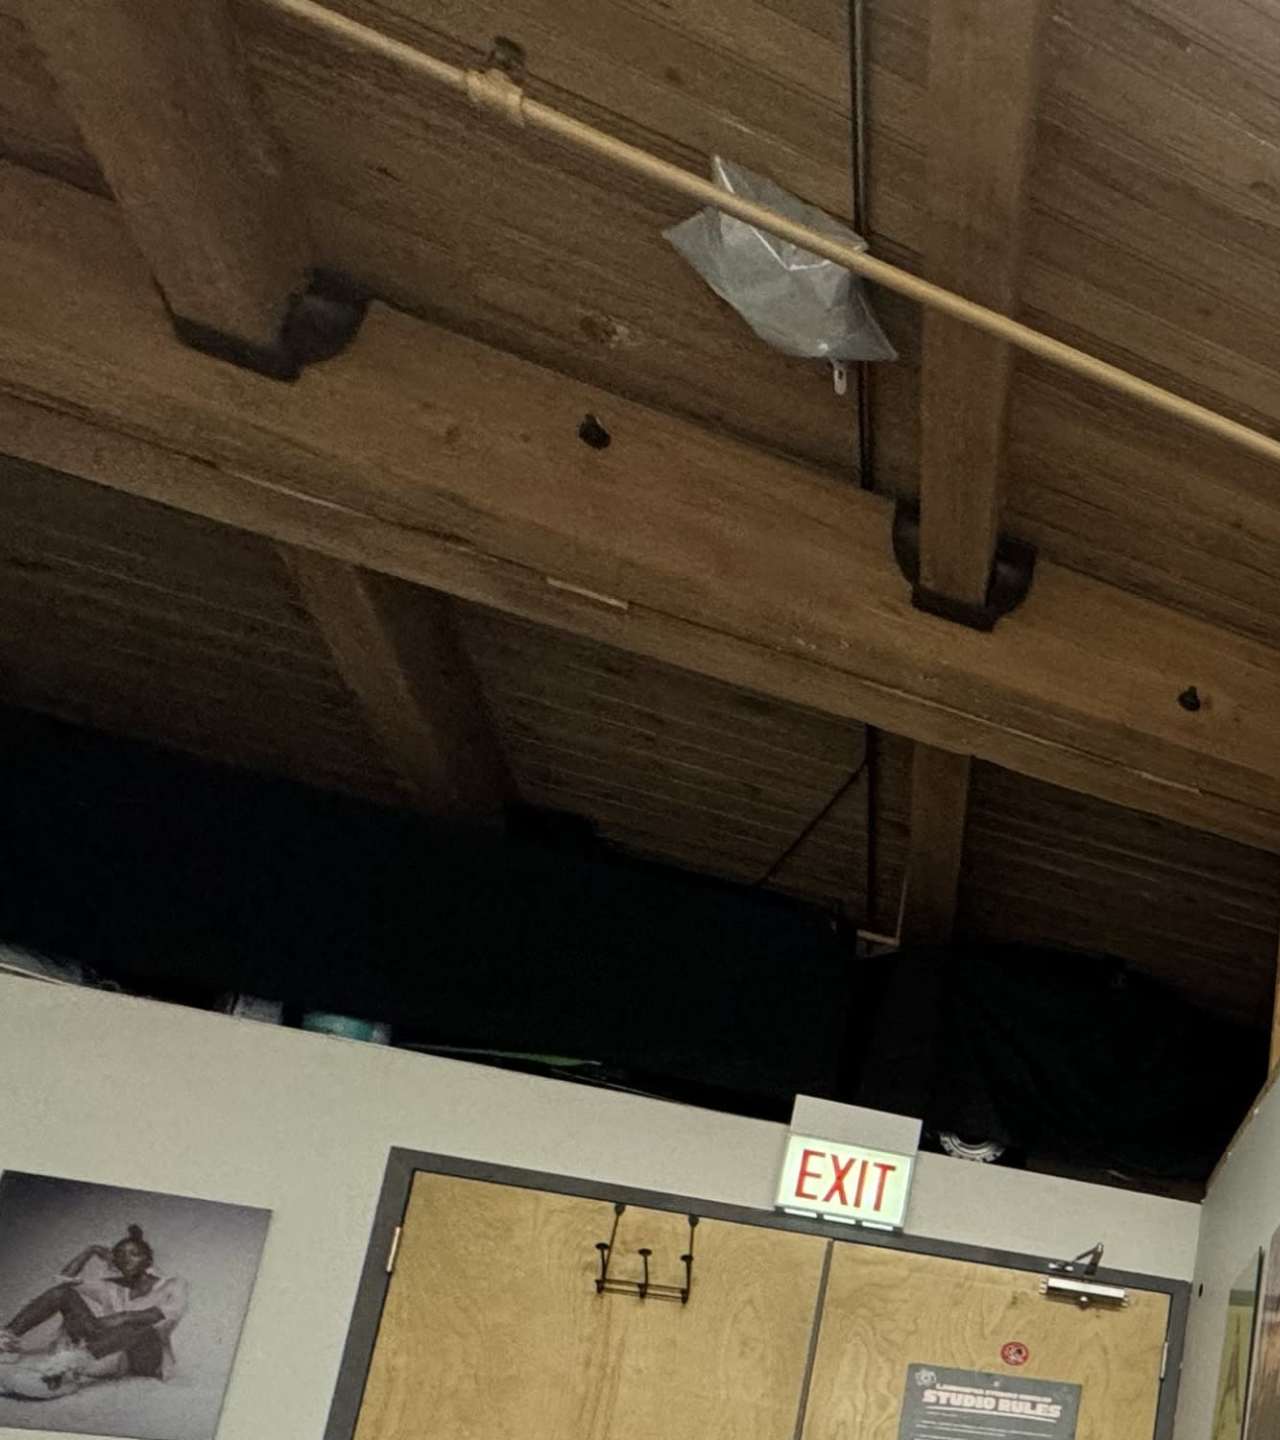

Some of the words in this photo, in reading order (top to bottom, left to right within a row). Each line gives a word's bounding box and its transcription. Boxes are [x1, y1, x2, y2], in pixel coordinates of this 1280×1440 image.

[794, 1147, 897, 1212] EXIT
[921, 1387, 997, 1412] STUDIO
[998, 1399, 1063, 1419] RULES
